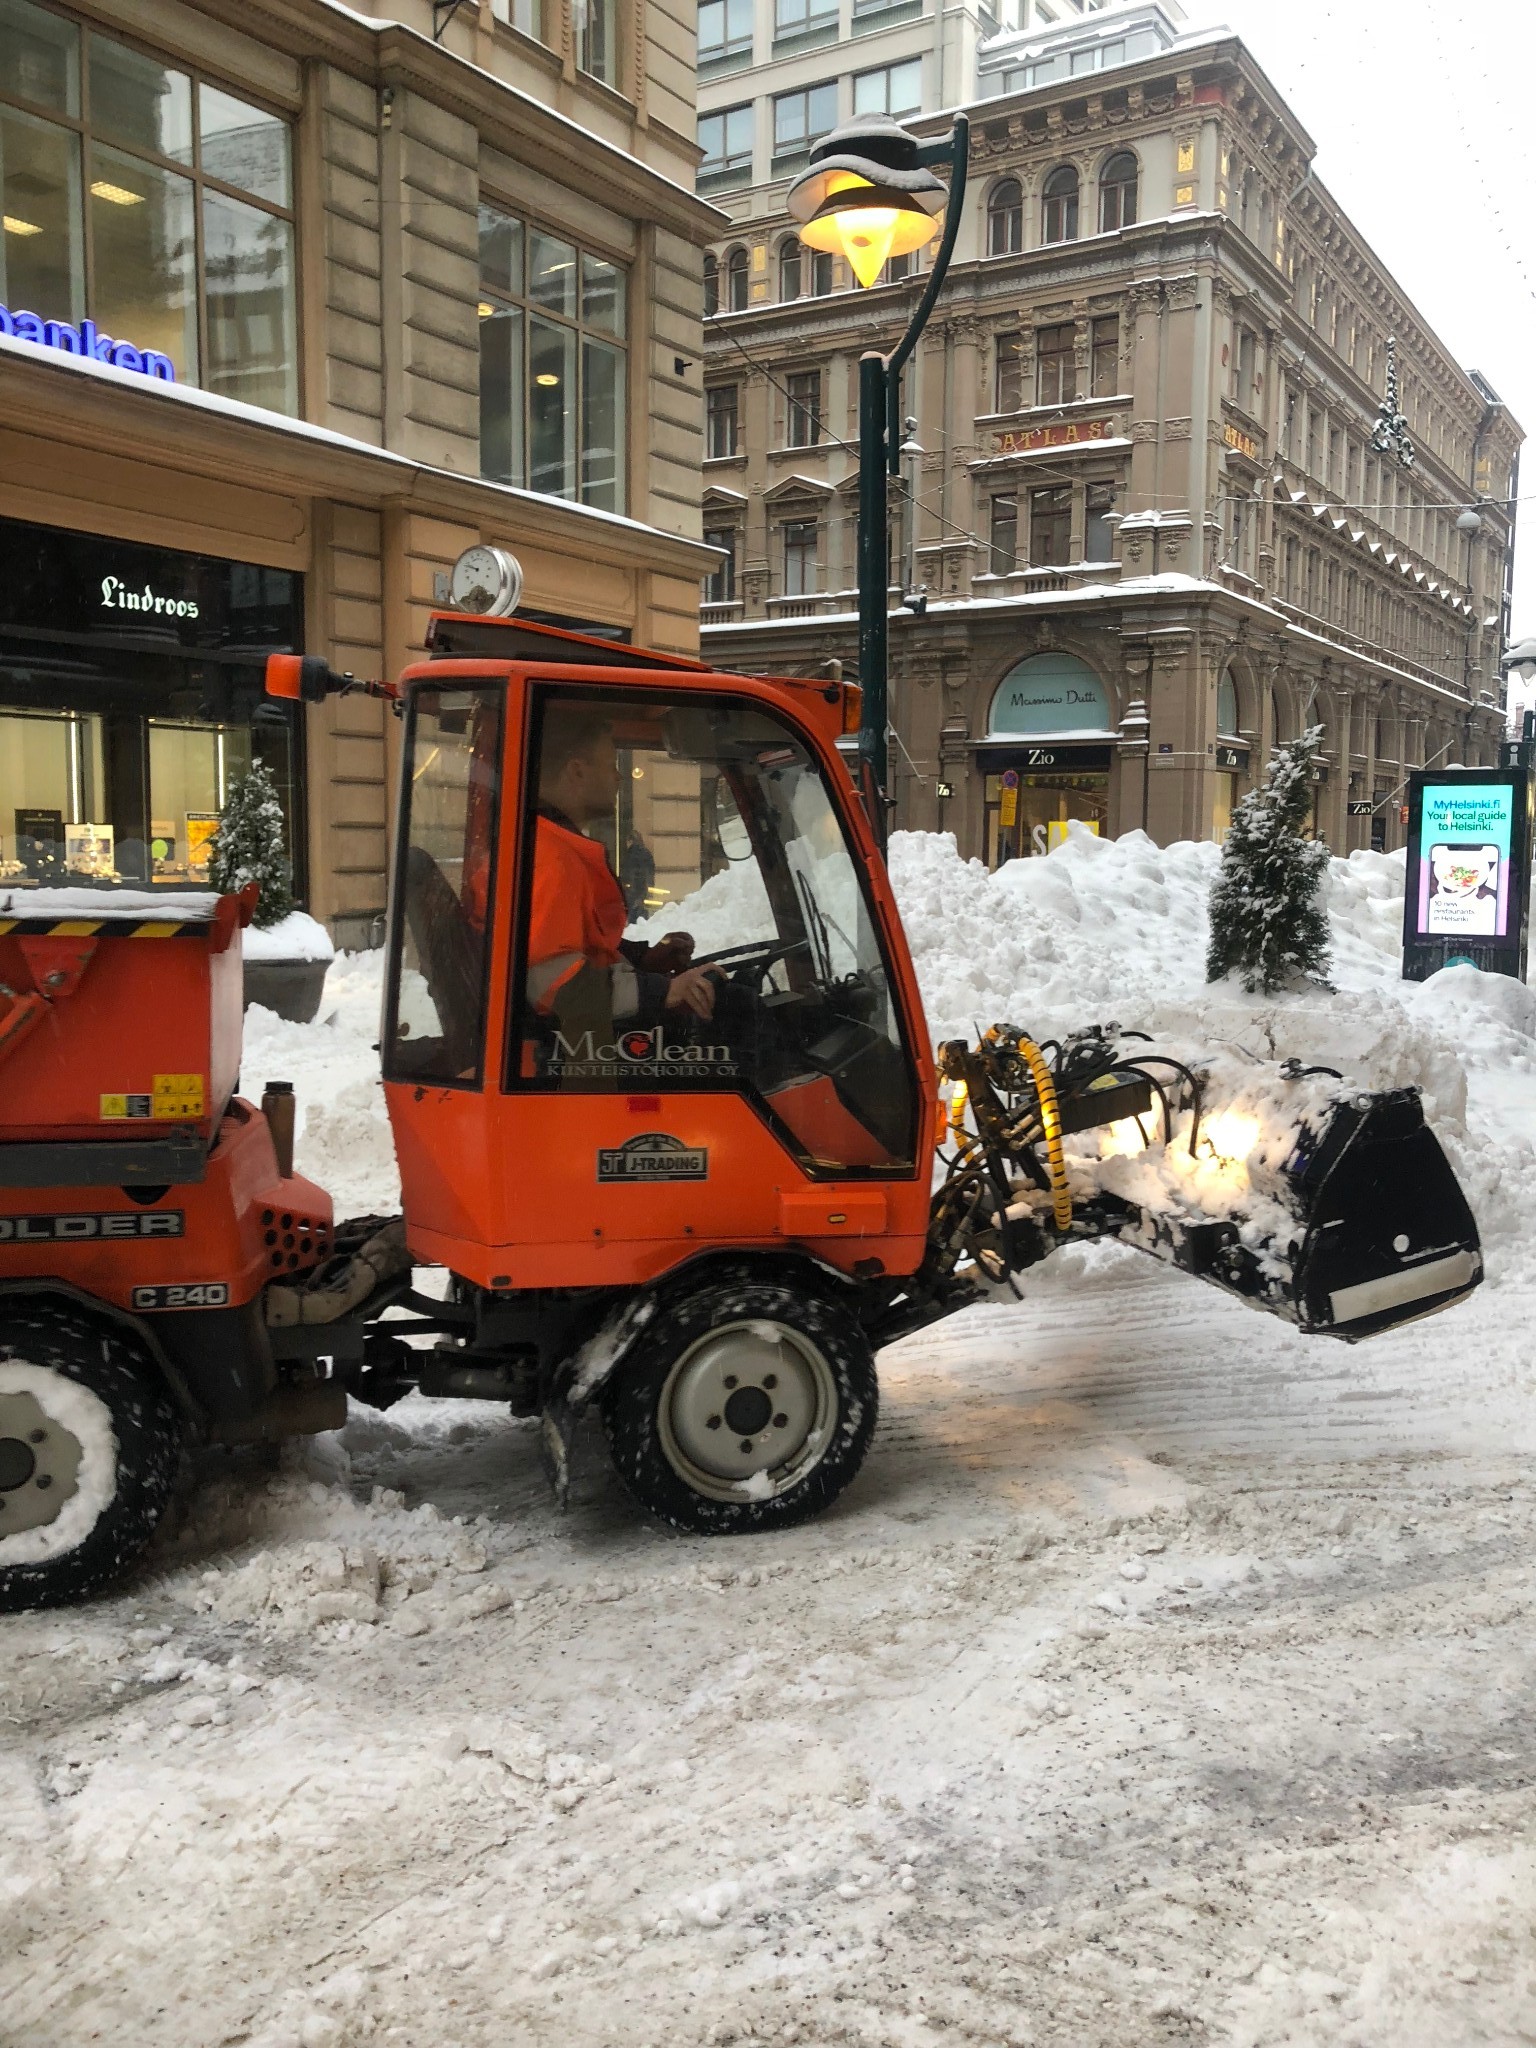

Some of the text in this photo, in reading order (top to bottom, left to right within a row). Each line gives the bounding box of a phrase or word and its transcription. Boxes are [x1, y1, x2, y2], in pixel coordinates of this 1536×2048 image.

[1000, 422, 1101, 452] ATLAS
[101, 575, 199, 619] Lindroos
[1011, 689, 1097, 707] Massimo Dutti
[1028, 749, 1055, 765] Zio
[1353, 803, 1371, 814] Zio
[1433, 799, 1501, 811] MyHelsinki.fi
[1427, 811, 1507, 823] Your local guide
[1438, 822, 1494, 831] to Helsinki.
[549, 1025, 734, 1063] McClean
[716, 1064, 740, 1076] OY
[631, 1156, 699, 1171] J-TRADING
[134, 1285, 226, 1308] C 240
